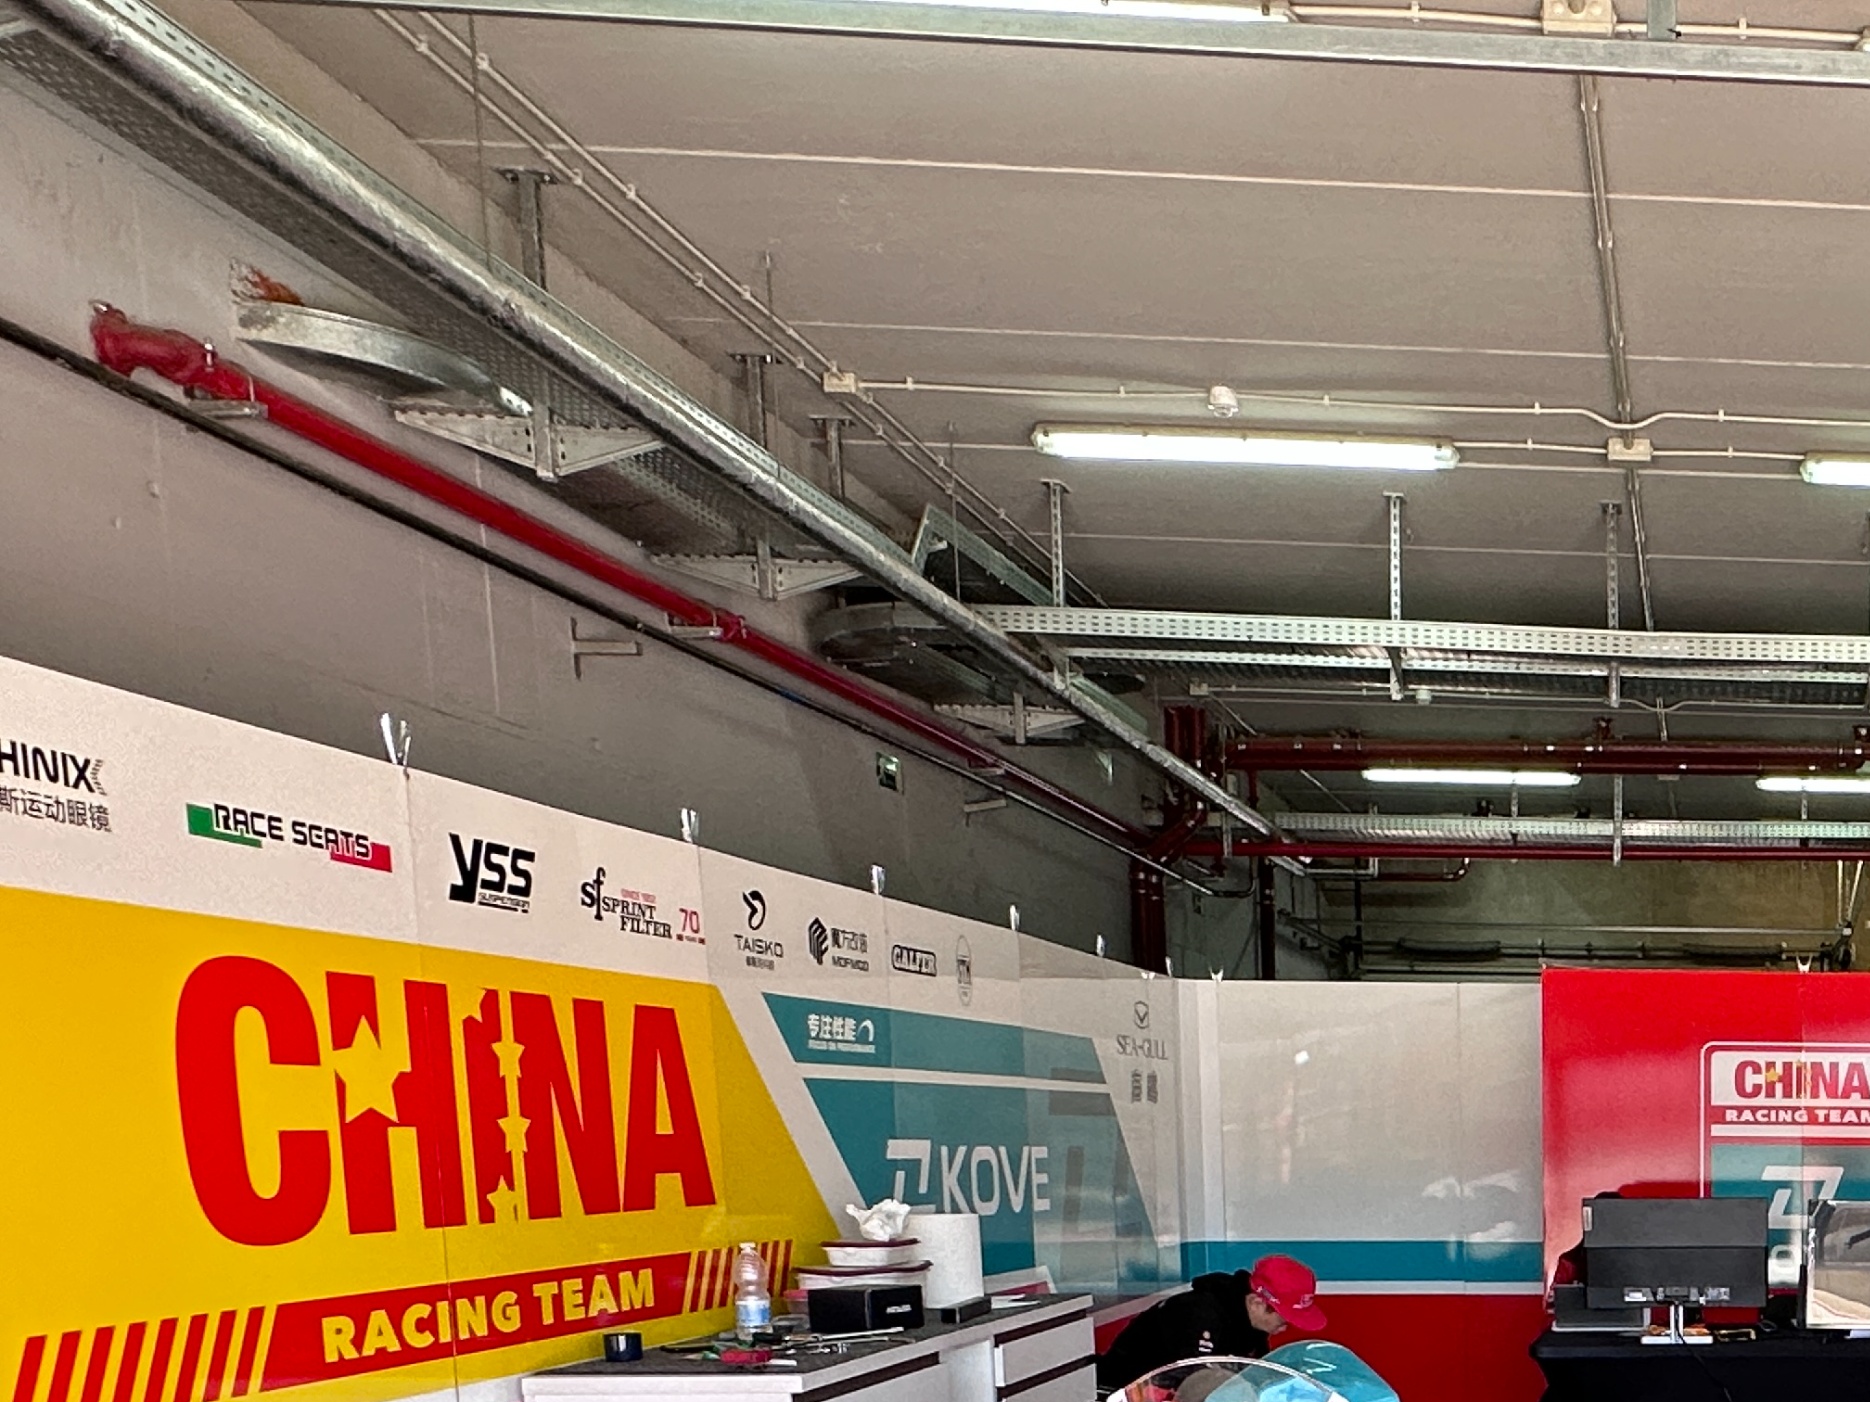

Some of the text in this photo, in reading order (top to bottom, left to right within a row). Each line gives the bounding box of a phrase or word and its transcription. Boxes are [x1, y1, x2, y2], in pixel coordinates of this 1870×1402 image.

[214, 803, 370, 858] RACE SEATS
[602, 896, 656, 920] SPRINT
[679, 907, 701, 934] 70
[620, 914, 673, 939] FILTER
[733, 933, 784, 958] TAISKO
[807, 1013, 857, 1041] 专注性能
[175, 955, 717, 1247] CHINA
[1725, 1108, 1809, 1124] RACING
[940, 1143, 1051, 1216] KOVE
[321, 1267, 656, 1364] RACING TEAM
